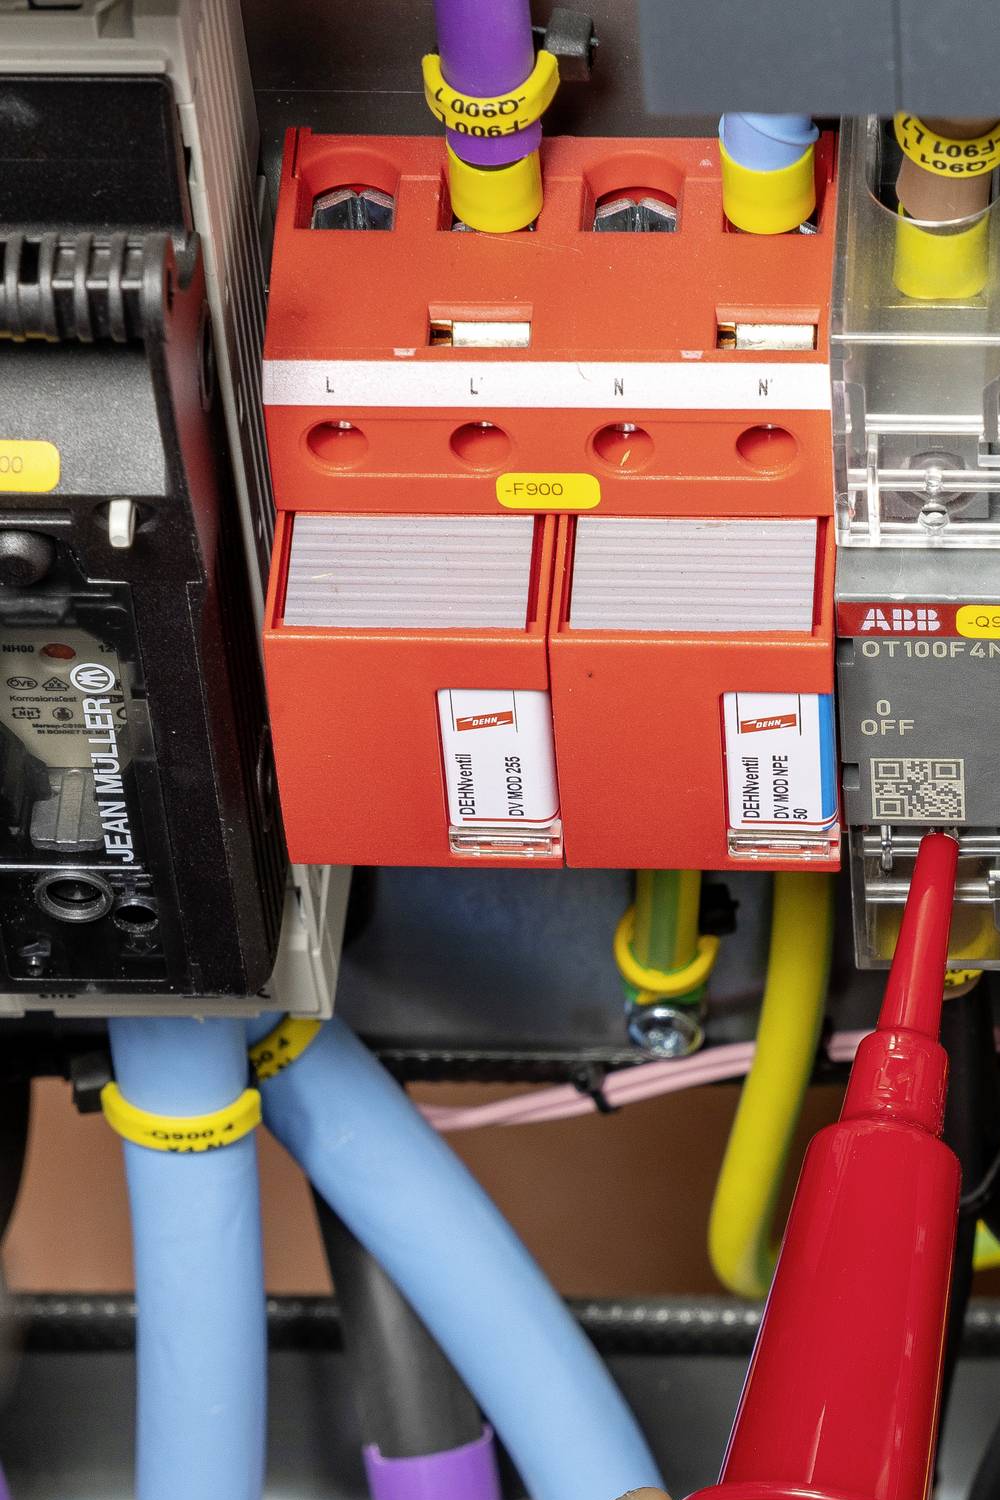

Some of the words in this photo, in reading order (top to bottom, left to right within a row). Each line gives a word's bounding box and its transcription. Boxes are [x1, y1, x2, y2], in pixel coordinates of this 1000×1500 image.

[451, 96, 526, 118] -Q900
[920, 153, 997, 173] -Q901
[325, 376, 335, 394] L
[613, 377, 625, 397] N
[504, 482, 565, 497] -F900
[860, 608, 942, 632] ABB
[472, 716, 499, 727] DEHN
[756, 719, 782, 729] DEHN
[860, 719, 916, 736] OFF
[82, 698, 124, 794] MÜLLER
[504, 756, 521, 774] 255
[772, 755, 789, 779] NPE
[455, 753, 476, 816] DEHNventil
[507, 776, 523, 800] MOD
[741, 757, 760, 819] DEHNventil
[773, 779, 789, 804] MOD
[508, 802, 524, 816] DV
[774, 805, 790, 819] DV
[793, 808, 808, 820] 50
[97, 801, 135, 862] JEAN
